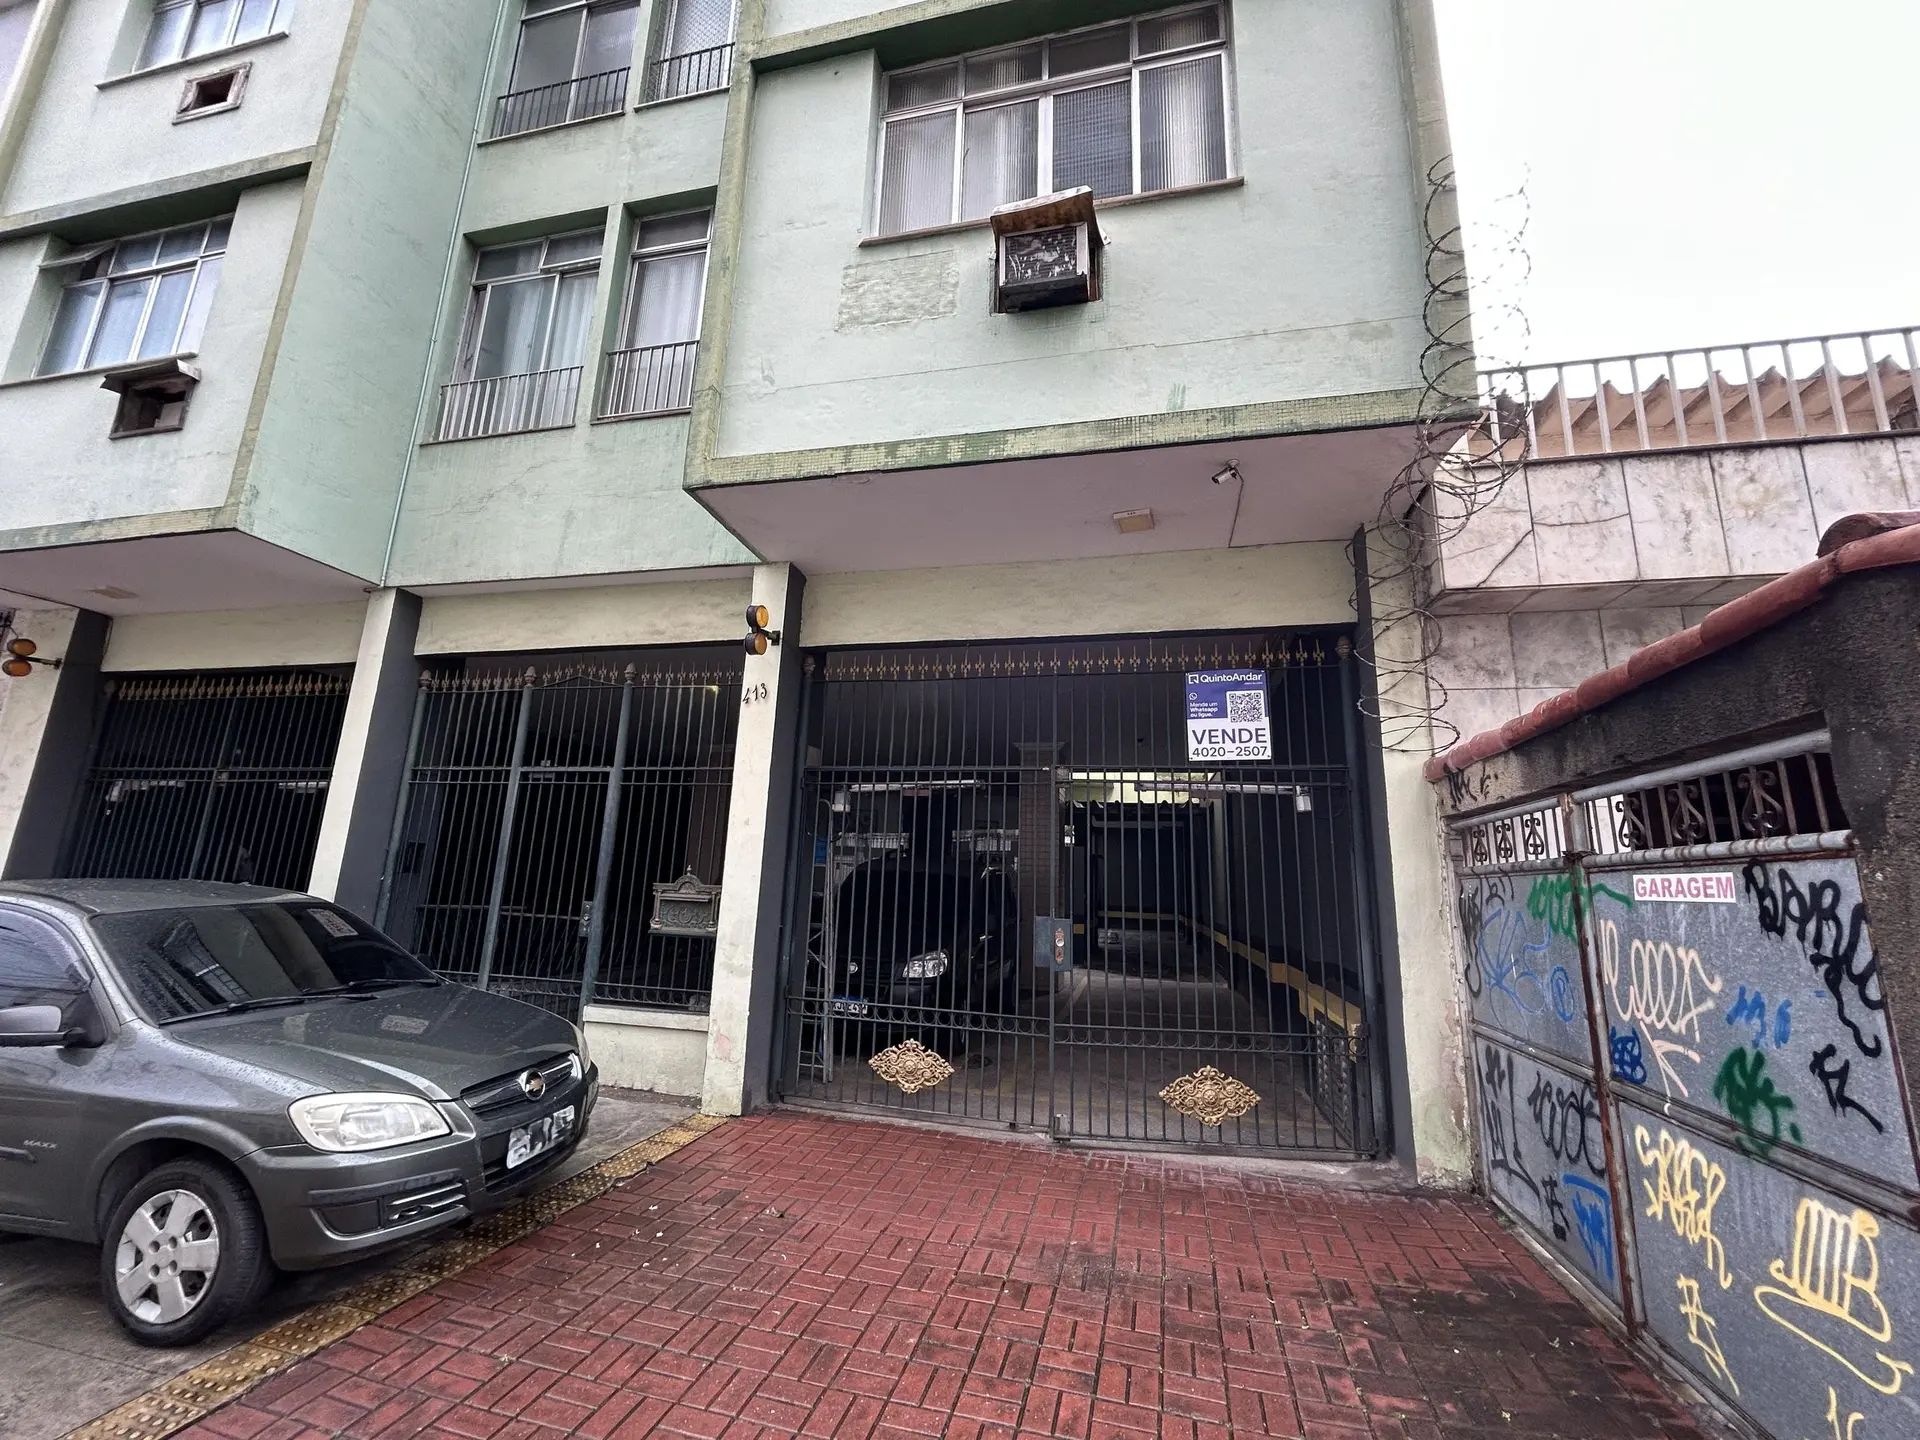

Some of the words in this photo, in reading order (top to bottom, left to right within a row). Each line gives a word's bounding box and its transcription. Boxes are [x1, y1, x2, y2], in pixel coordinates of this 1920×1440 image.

[1200, 672, 1263, 683] QuintoAndar
[742, 682, 767, 704] 413
[1191, 727, 1268, 745] VENDE
[1192, 746, 1268, 757] 4020-2507
[1635, 876, 1734, 899] GARAGEM
